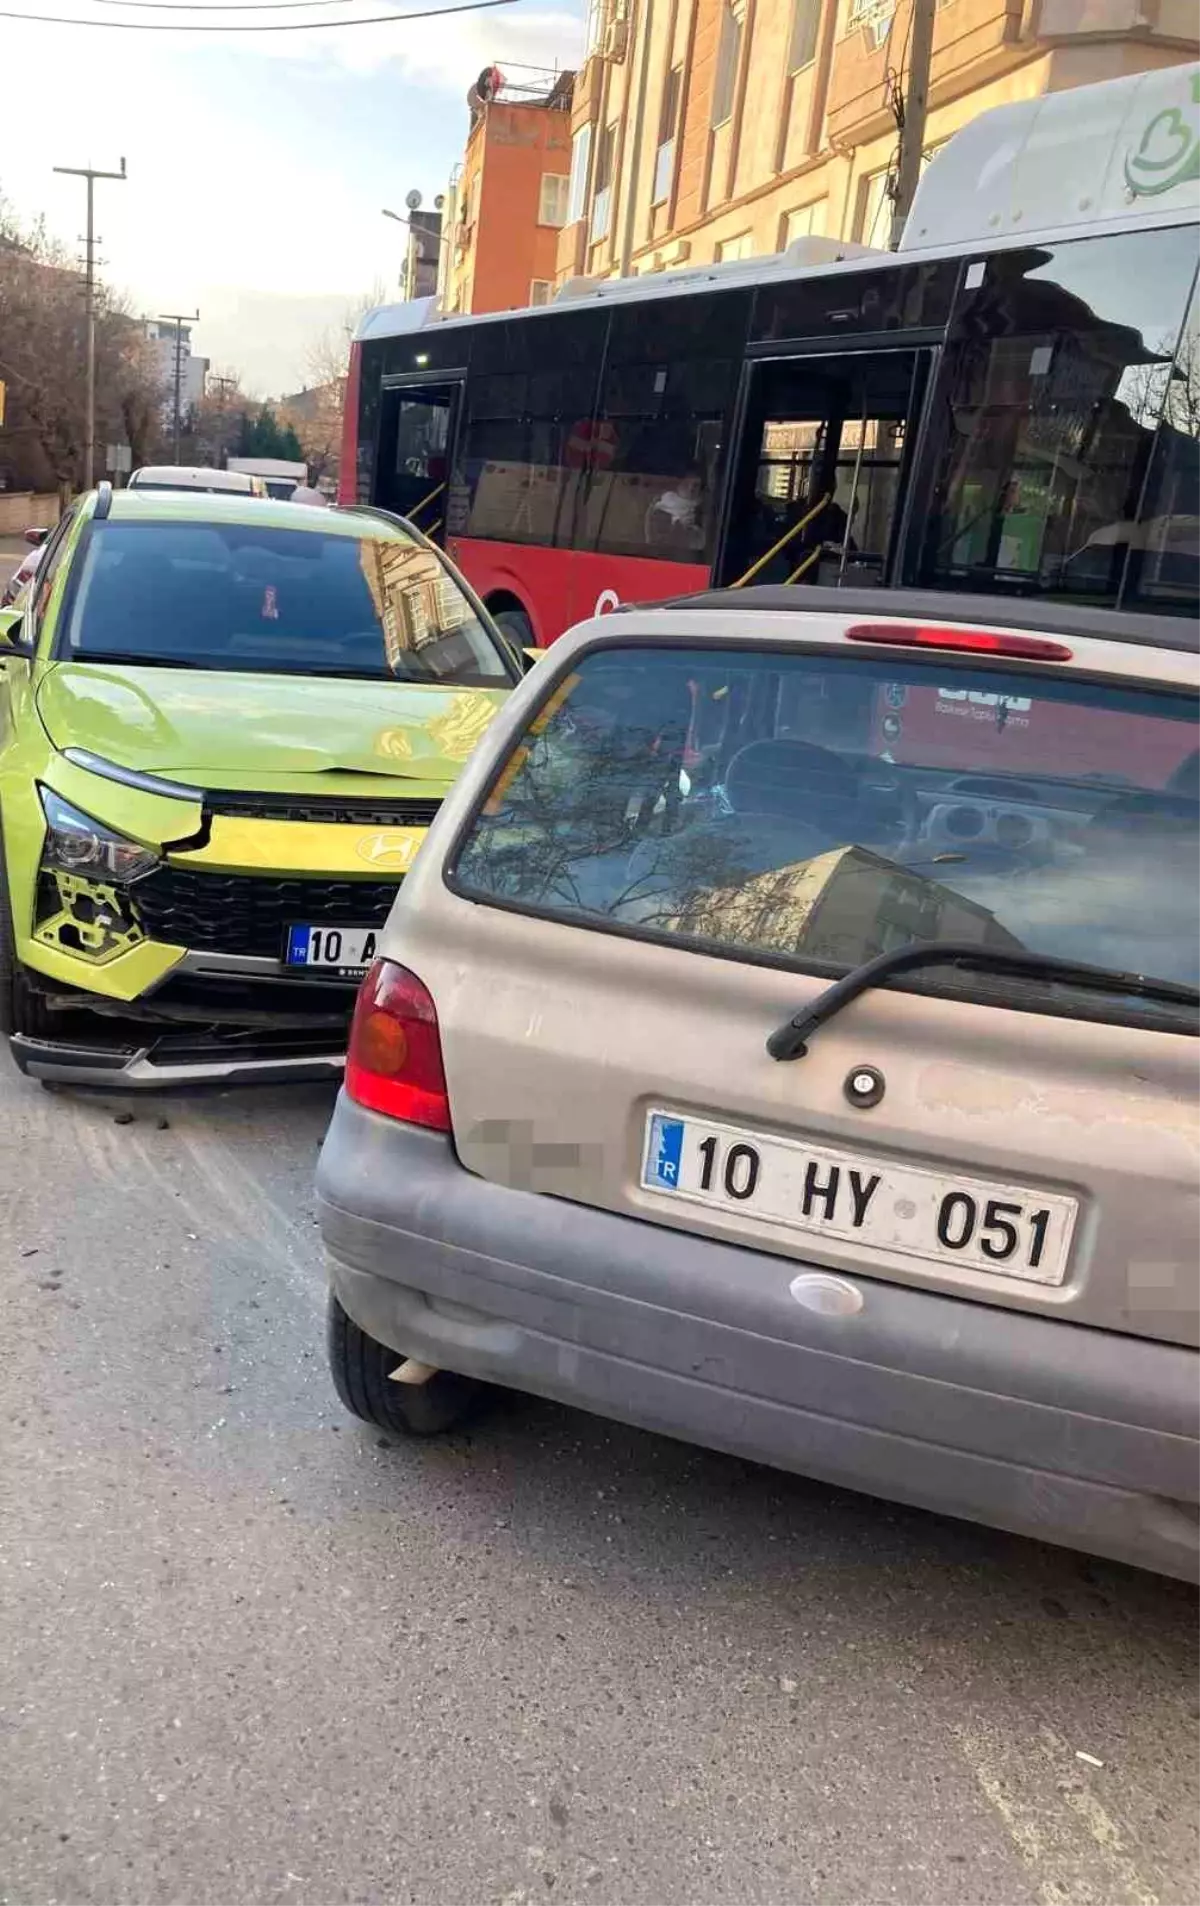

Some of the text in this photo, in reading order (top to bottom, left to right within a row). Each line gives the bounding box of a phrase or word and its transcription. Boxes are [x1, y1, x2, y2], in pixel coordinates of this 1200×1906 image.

[293, 947, 306, 958] TR
[311, 930, 342, 963] 10
[655, 1159, 677, 1179] TR
[699, 1135, 1051, 1268] 10 HY 051
